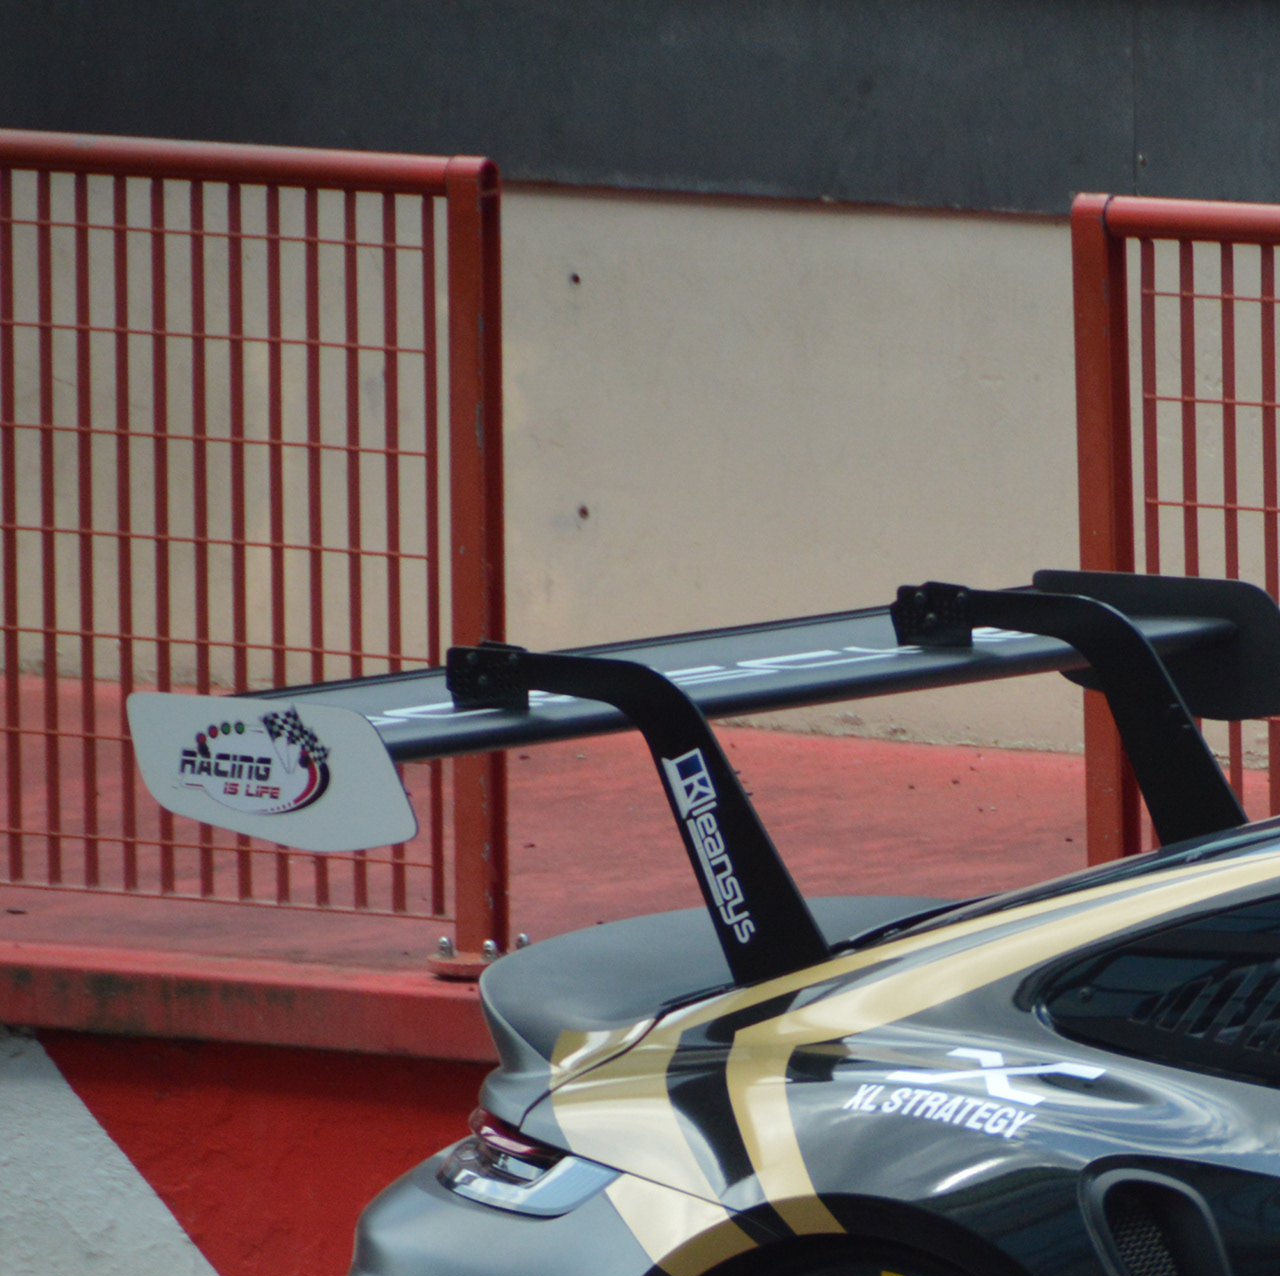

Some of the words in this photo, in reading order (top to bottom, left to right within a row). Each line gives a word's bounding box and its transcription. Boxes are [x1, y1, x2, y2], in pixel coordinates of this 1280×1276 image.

[180, 748, 272, 781] RACING
[223, 782, 239, 796] IS
[245, 783, 281, 800] LIFE
[661, 747, 756, 945] Kleansys
[842, 1084, 885, 1112] XL
[881, 1087, 1037, 1139] STRATEGY
